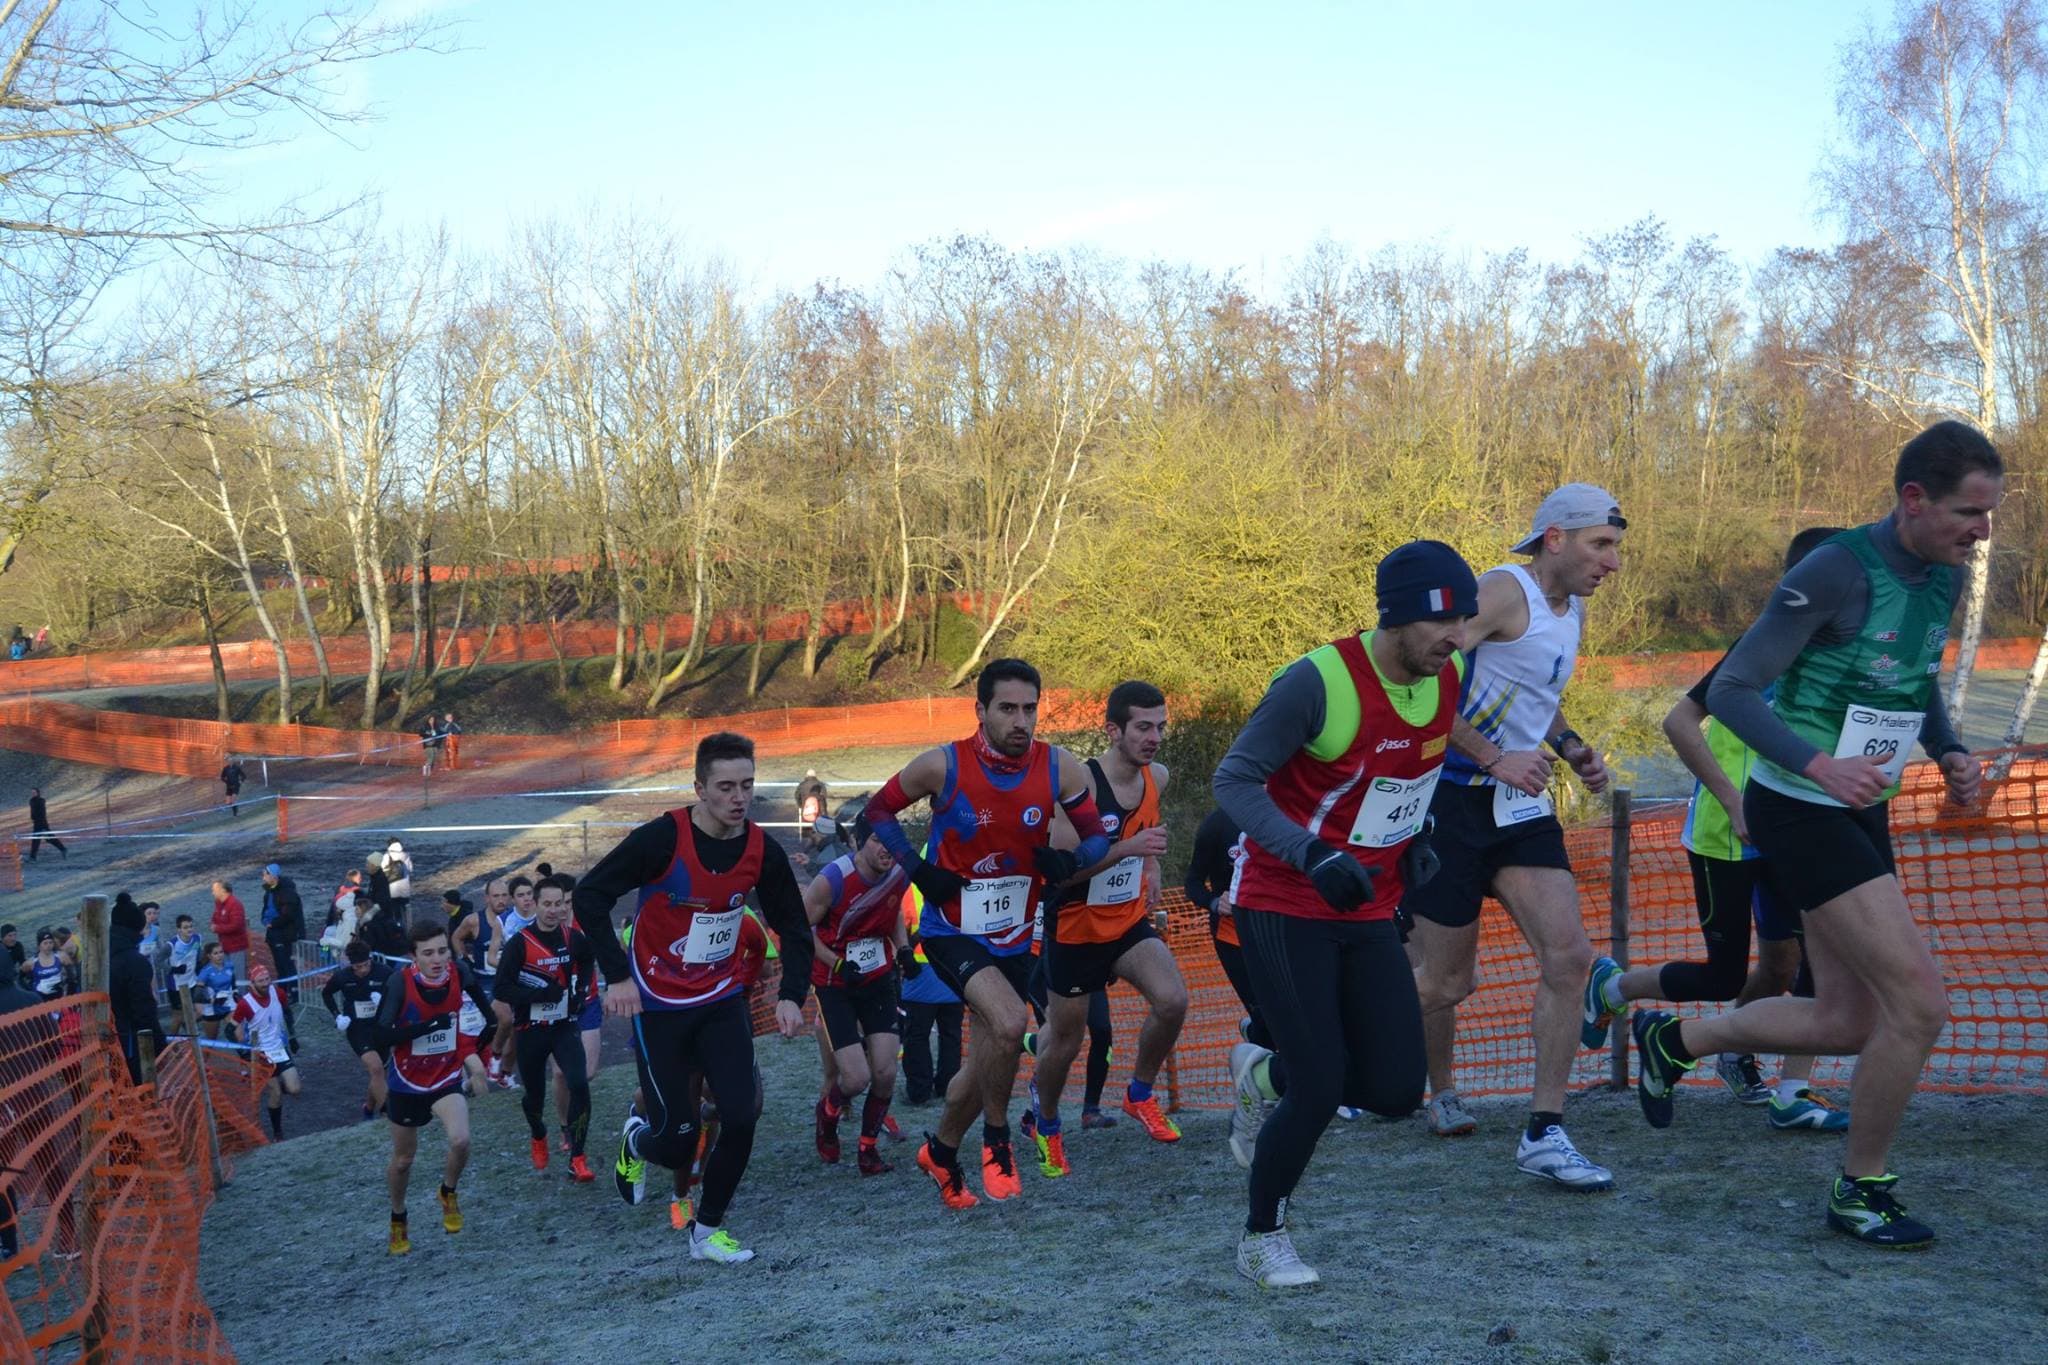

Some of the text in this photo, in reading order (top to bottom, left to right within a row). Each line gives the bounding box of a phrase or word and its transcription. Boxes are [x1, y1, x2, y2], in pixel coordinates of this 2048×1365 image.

[1864, 738, 1899, 757] 628
[1387, 798, 1420, 823] 413
[1107, 872, 1132, 888] 467
[983, 896, 1010, 914] 116
[708, 928, 732, 945] 106
